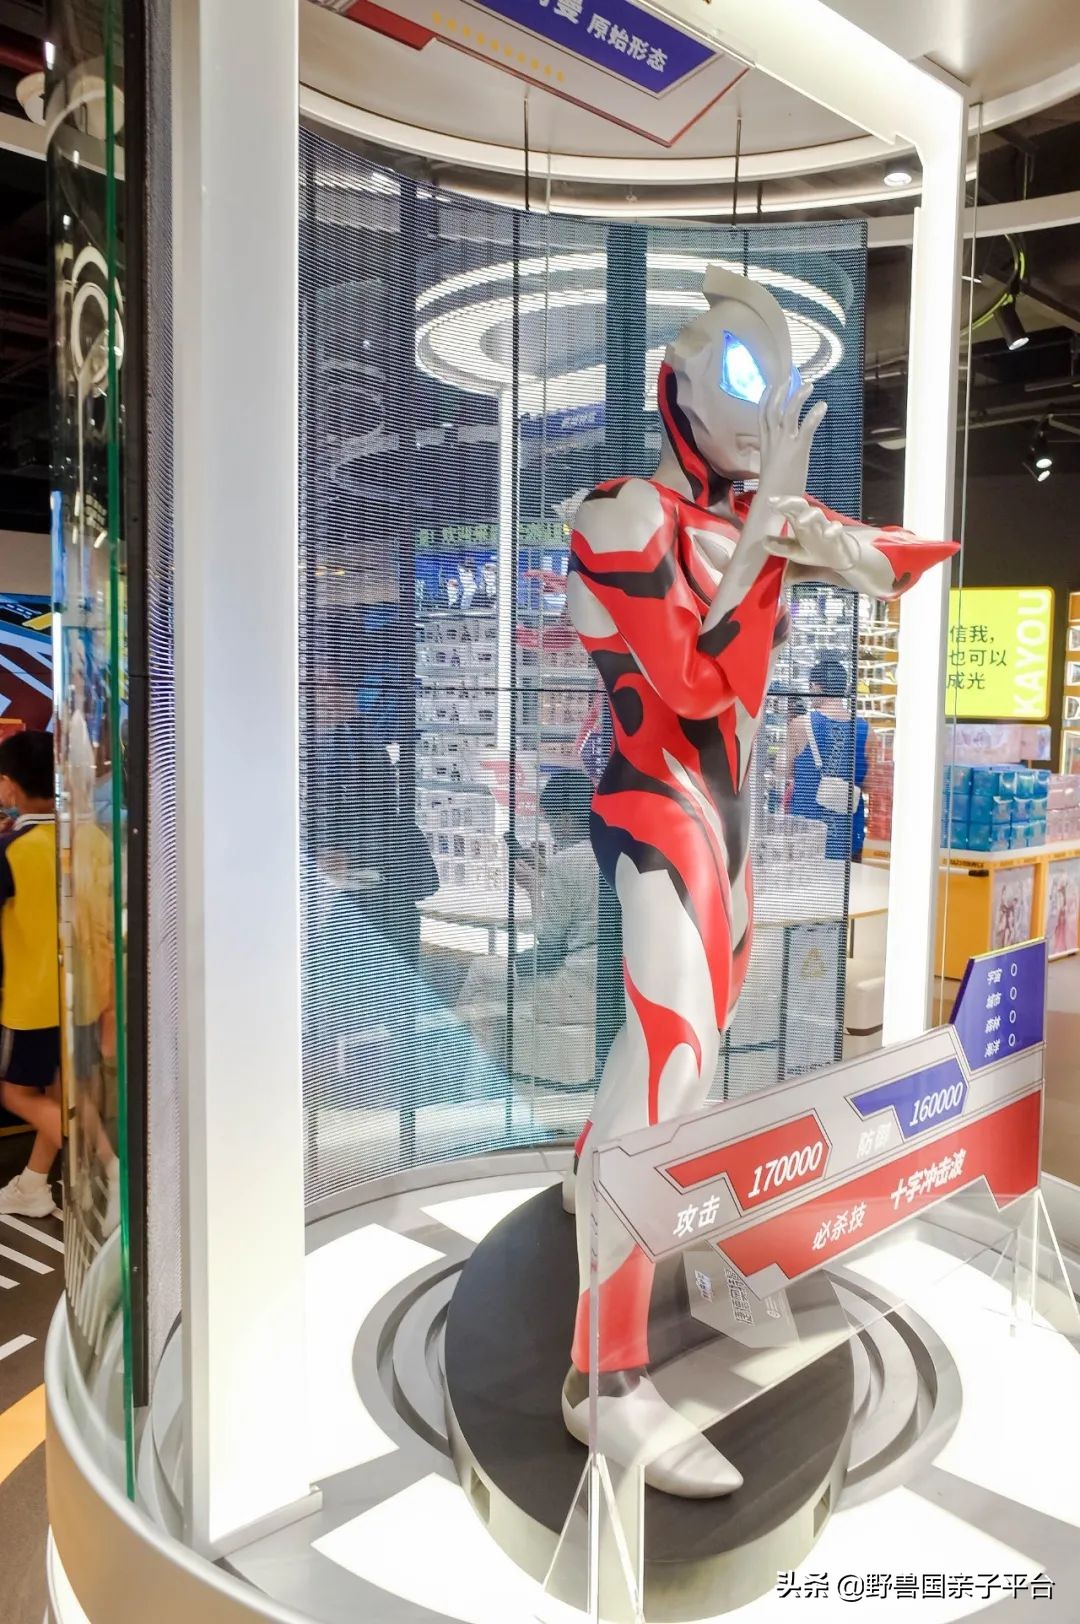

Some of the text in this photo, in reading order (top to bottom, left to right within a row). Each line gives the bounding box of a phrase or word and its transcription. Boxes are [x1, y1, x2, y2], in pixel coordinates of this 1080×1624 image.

[586, 13, 668, 73] 原始形态
[949, 650, 1007, 667] 也可以
[1012, 591, 1049, 715] KAYOU
[946, 672, 985, 690] 成光
[987, 968, 1003, 985] 宇宙
[909, 1082, 964, 1127] 160000
[747, 1141, 824, 1198] 170000
[672, 1195, 721, 1238] 攻击
[811, 1148, 968, 1251] 必杀技 十字冲击波
